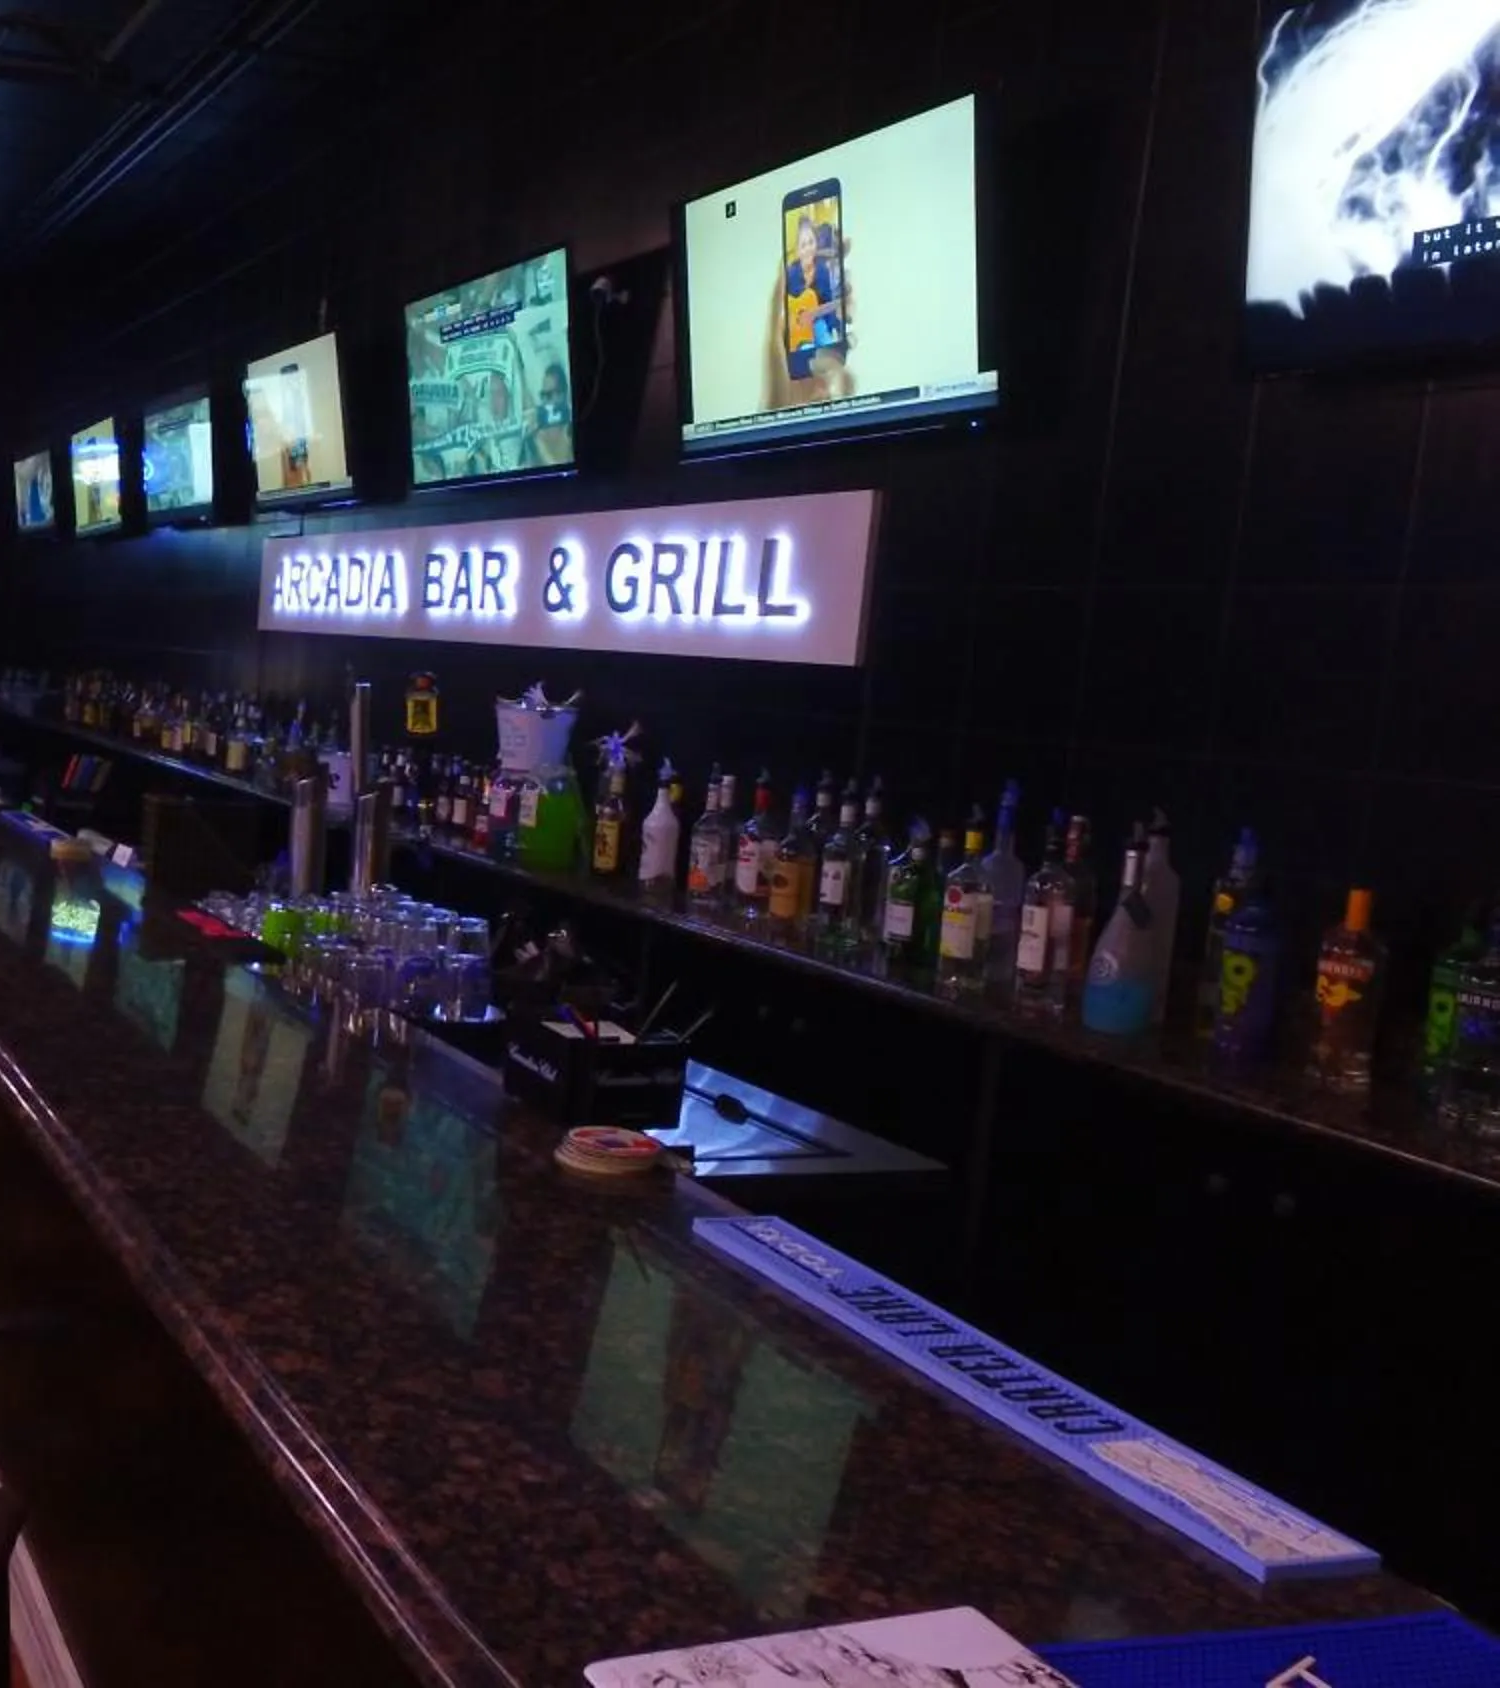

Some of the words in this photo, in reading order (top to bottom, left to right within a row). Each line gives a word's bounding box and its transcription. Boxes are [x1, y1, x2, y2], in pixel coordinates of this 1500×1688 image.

[1423, 228, 1451, 244] but
[1465, 222, 1483, 235] it
[271, 553, 402, 611] ARCADIA
[422, 549, 512, 613] BAR
[542, 545, 580, 615] &
[604, 537, 802, 618] GRILL
[828, 1282, 961, 1339] LAKE
[929, 1341, 1127, 1436] CRATER
